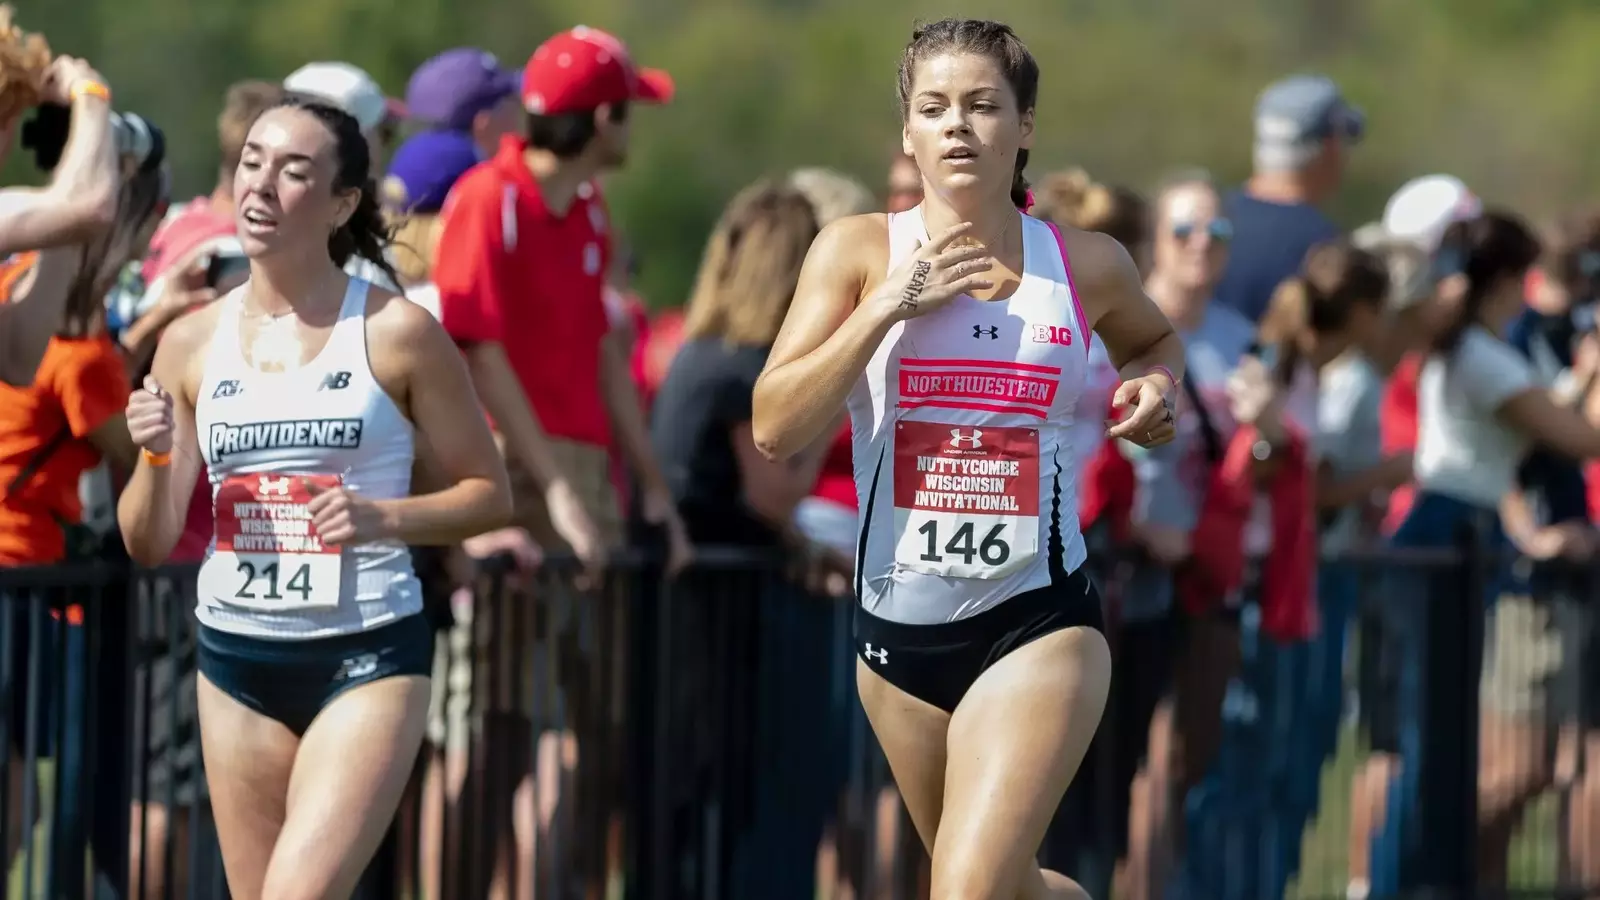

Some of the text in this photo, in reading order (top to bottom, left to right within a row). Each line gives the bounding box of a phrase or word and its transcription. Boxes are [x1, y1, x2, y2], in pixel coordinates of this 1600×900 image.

[898, 260, 931, 311] BREATHE
[907, 374, 1050, 401] NORTHWESTERN
[211, 418, 363, 463] PROVIDENCE
[916, 455, 1020, 477] NUTTYCOMBE
[925, 474, 1006, 493] WISCONSIN
[914, 490, 1020, 512] INVITATIONAL
[917, 519, 1011, 567] 146
[234, 561, 314, 601] 214
